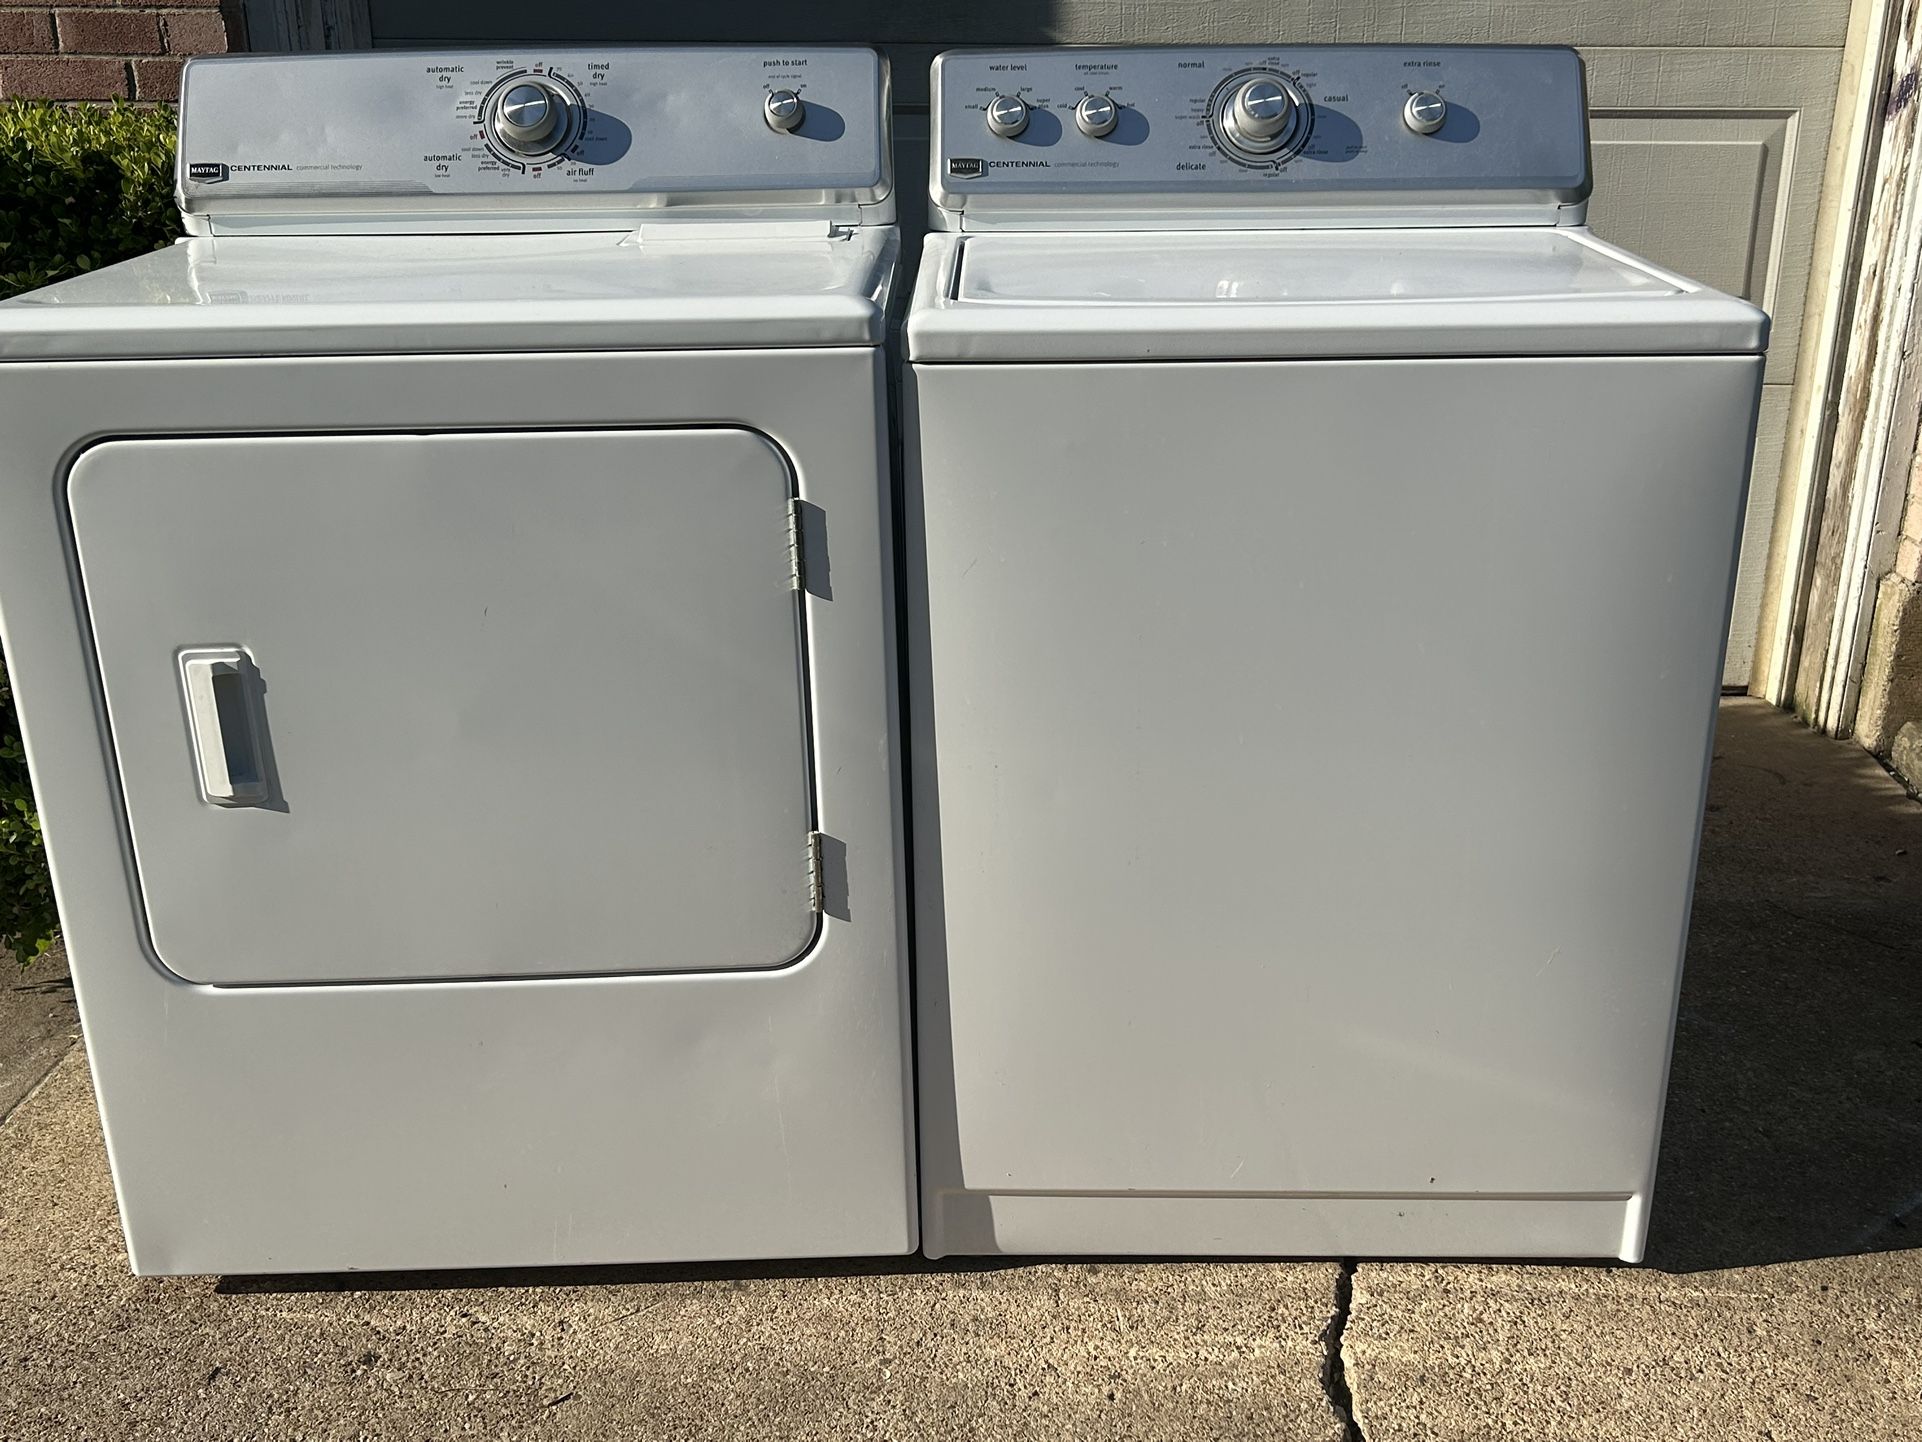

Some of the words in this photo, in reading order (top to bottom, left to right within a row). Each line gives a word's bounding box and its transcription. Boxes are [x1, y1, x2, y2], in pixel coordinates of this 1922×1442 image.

[426, 64, 465, 73] automatic
[588, 62, 610, 70] timed
[763, 60, 780, 68] push
[1178, 61, 1205, 69] normal
[438, 74, 451, 84] dry
[592, 71, 605, 80] dry
[1324, 94, 1349, 102] casual
[423, 153, 462, 162] automatic
[436, 163, 449, 173] dry
[1176, 162, 1207, 171] delicate
[566, 169, 578, 177] air
[578, 168, 595, 176] fluff
